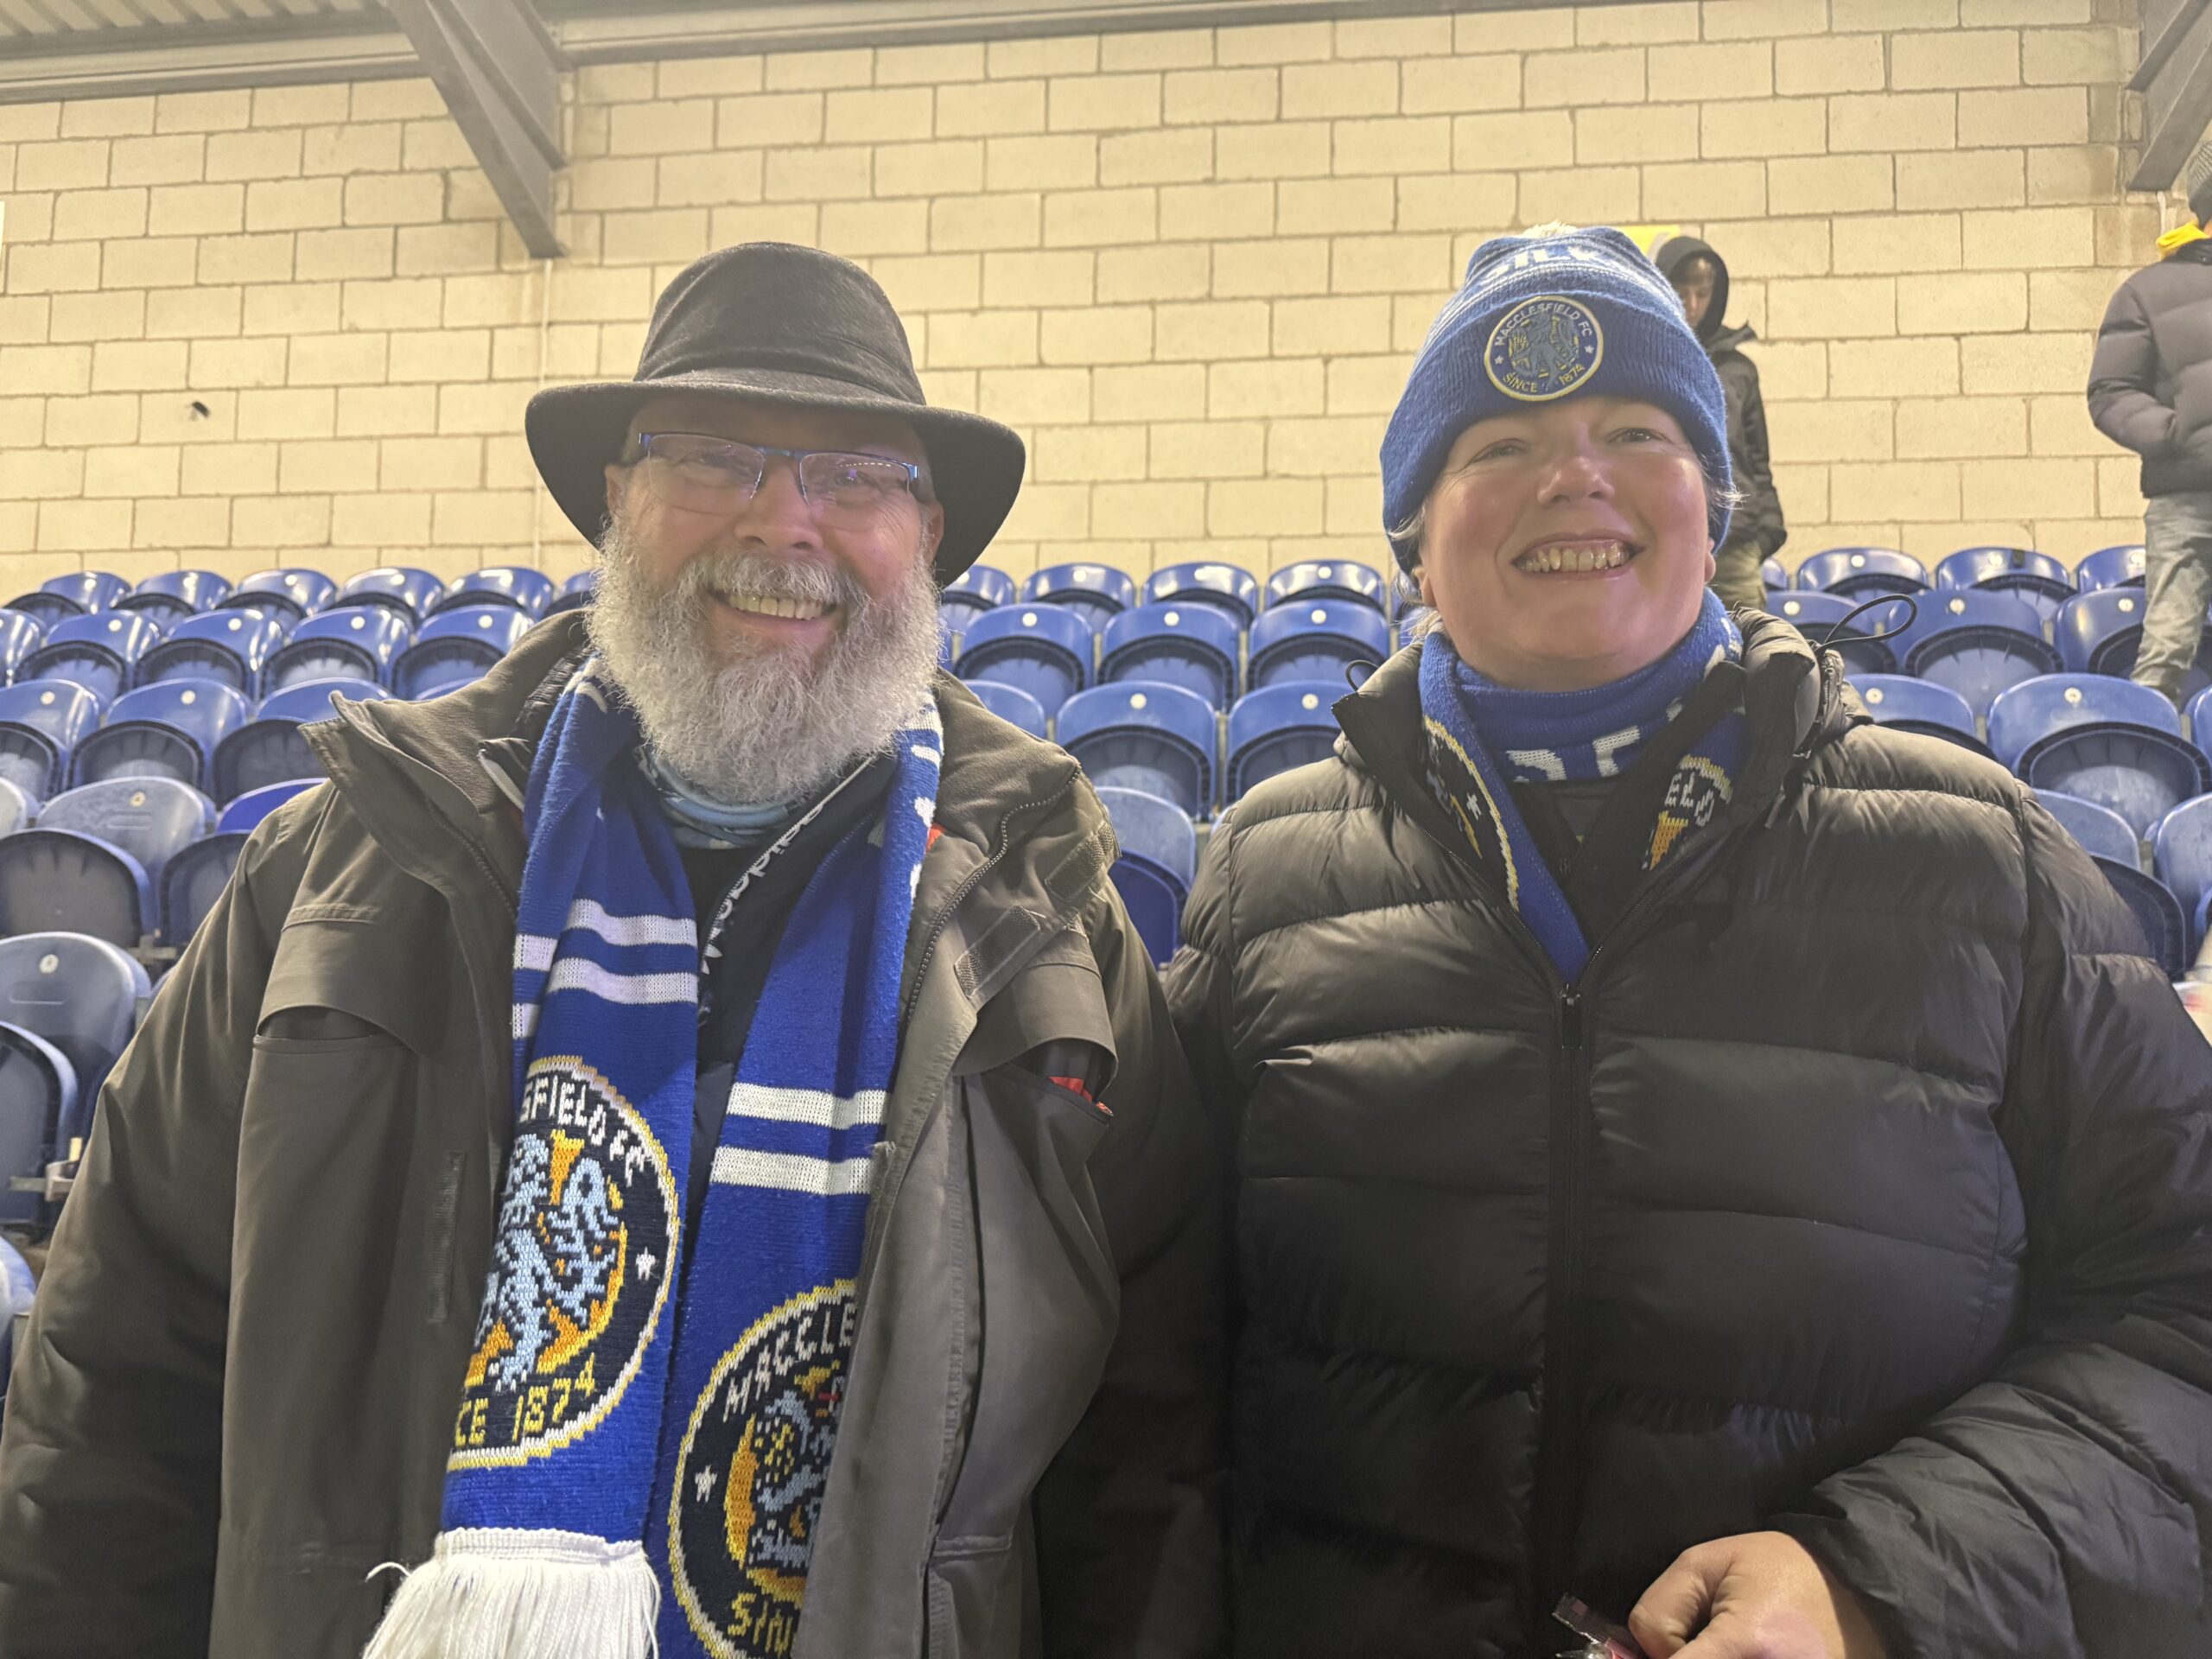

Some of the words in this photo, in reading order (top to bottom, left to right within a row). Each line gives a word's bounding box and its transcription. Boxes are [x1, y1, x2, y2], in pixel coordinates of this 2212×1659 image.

[1495, 302, 1580, 346] MACCLESFIELD
[1578, 321, 1592, 337] FC
[1503, 372, 1538, 393] SINCE
[1559, 363, 1586, 385] 1874
[1664, 772, 1715, 827] ELD
[518, 1074, 607, 1147] SFIELD
[723, 1302, 856, 1423] MACCLE
[512, 1352, 596, 1442] 1874
[728, 1592, 794, 1658] SIN
